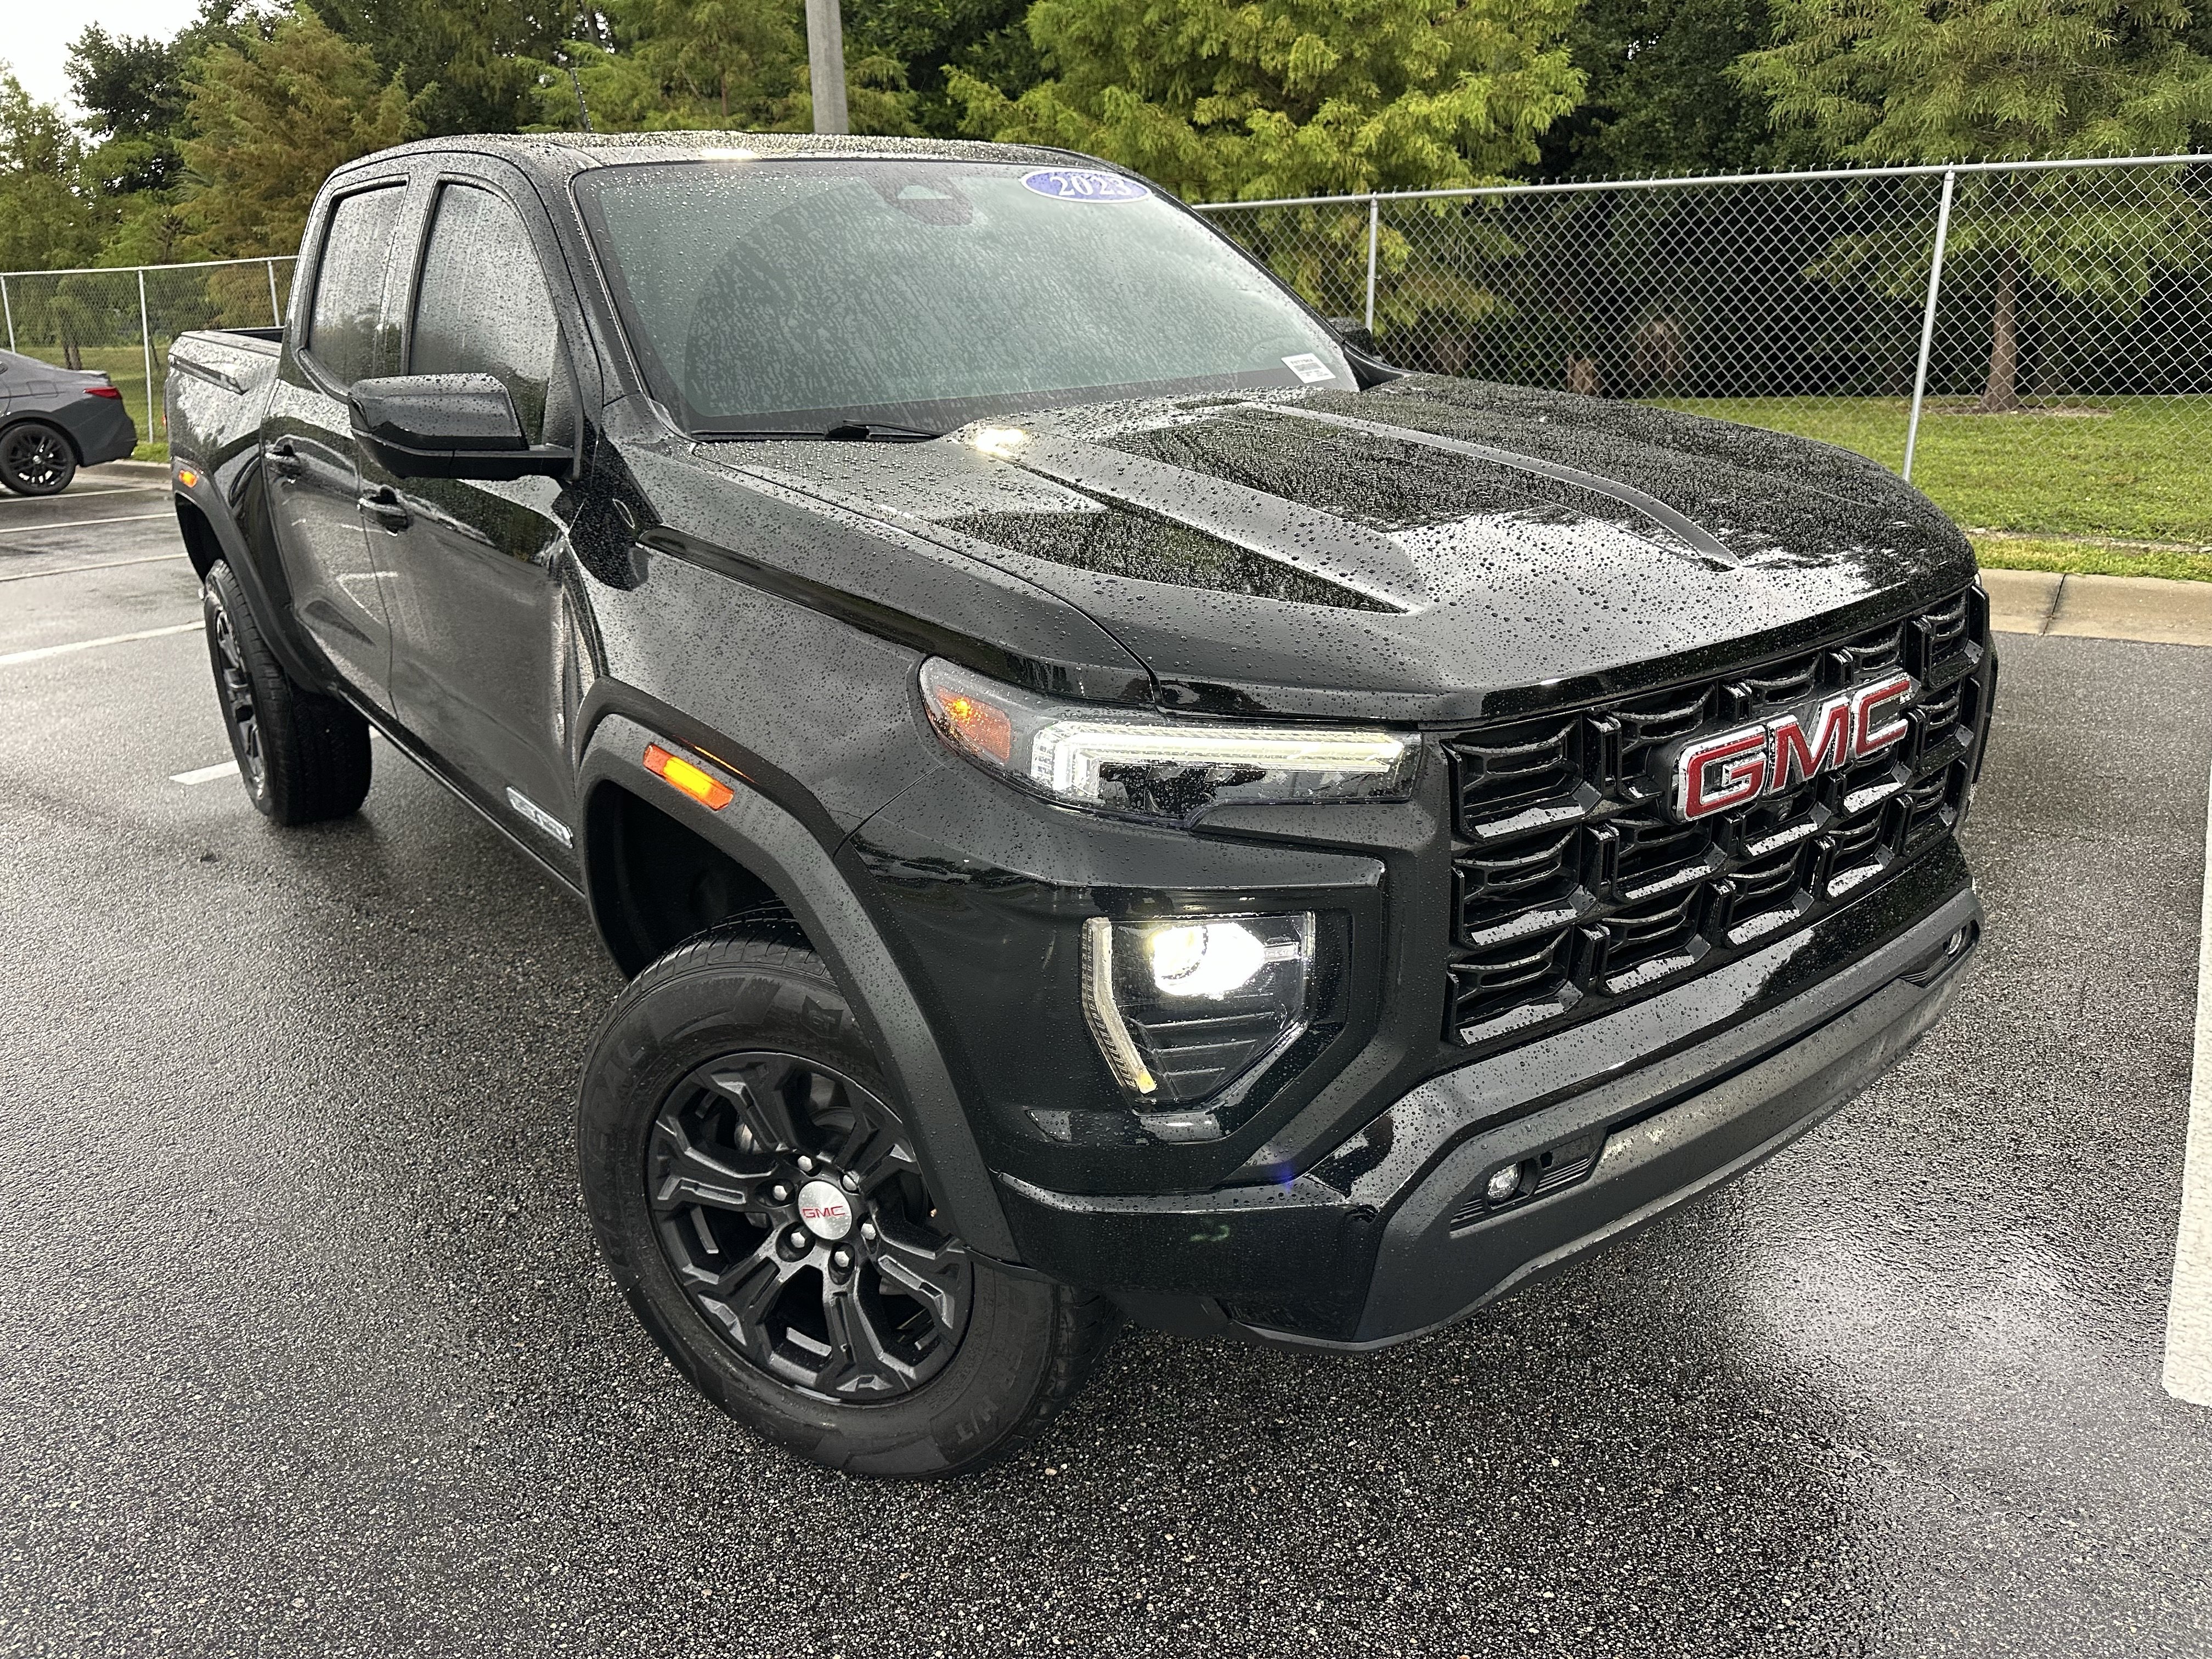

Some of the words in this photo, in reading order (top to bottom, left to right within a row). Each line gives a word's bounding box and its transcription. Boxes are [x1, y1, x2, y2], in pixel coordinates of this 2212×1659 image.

[1049, 173, 1132, 196] 2023
[1677, 672, 1911, 821] GMC
[802, 1205, 845, 1218] GMC
